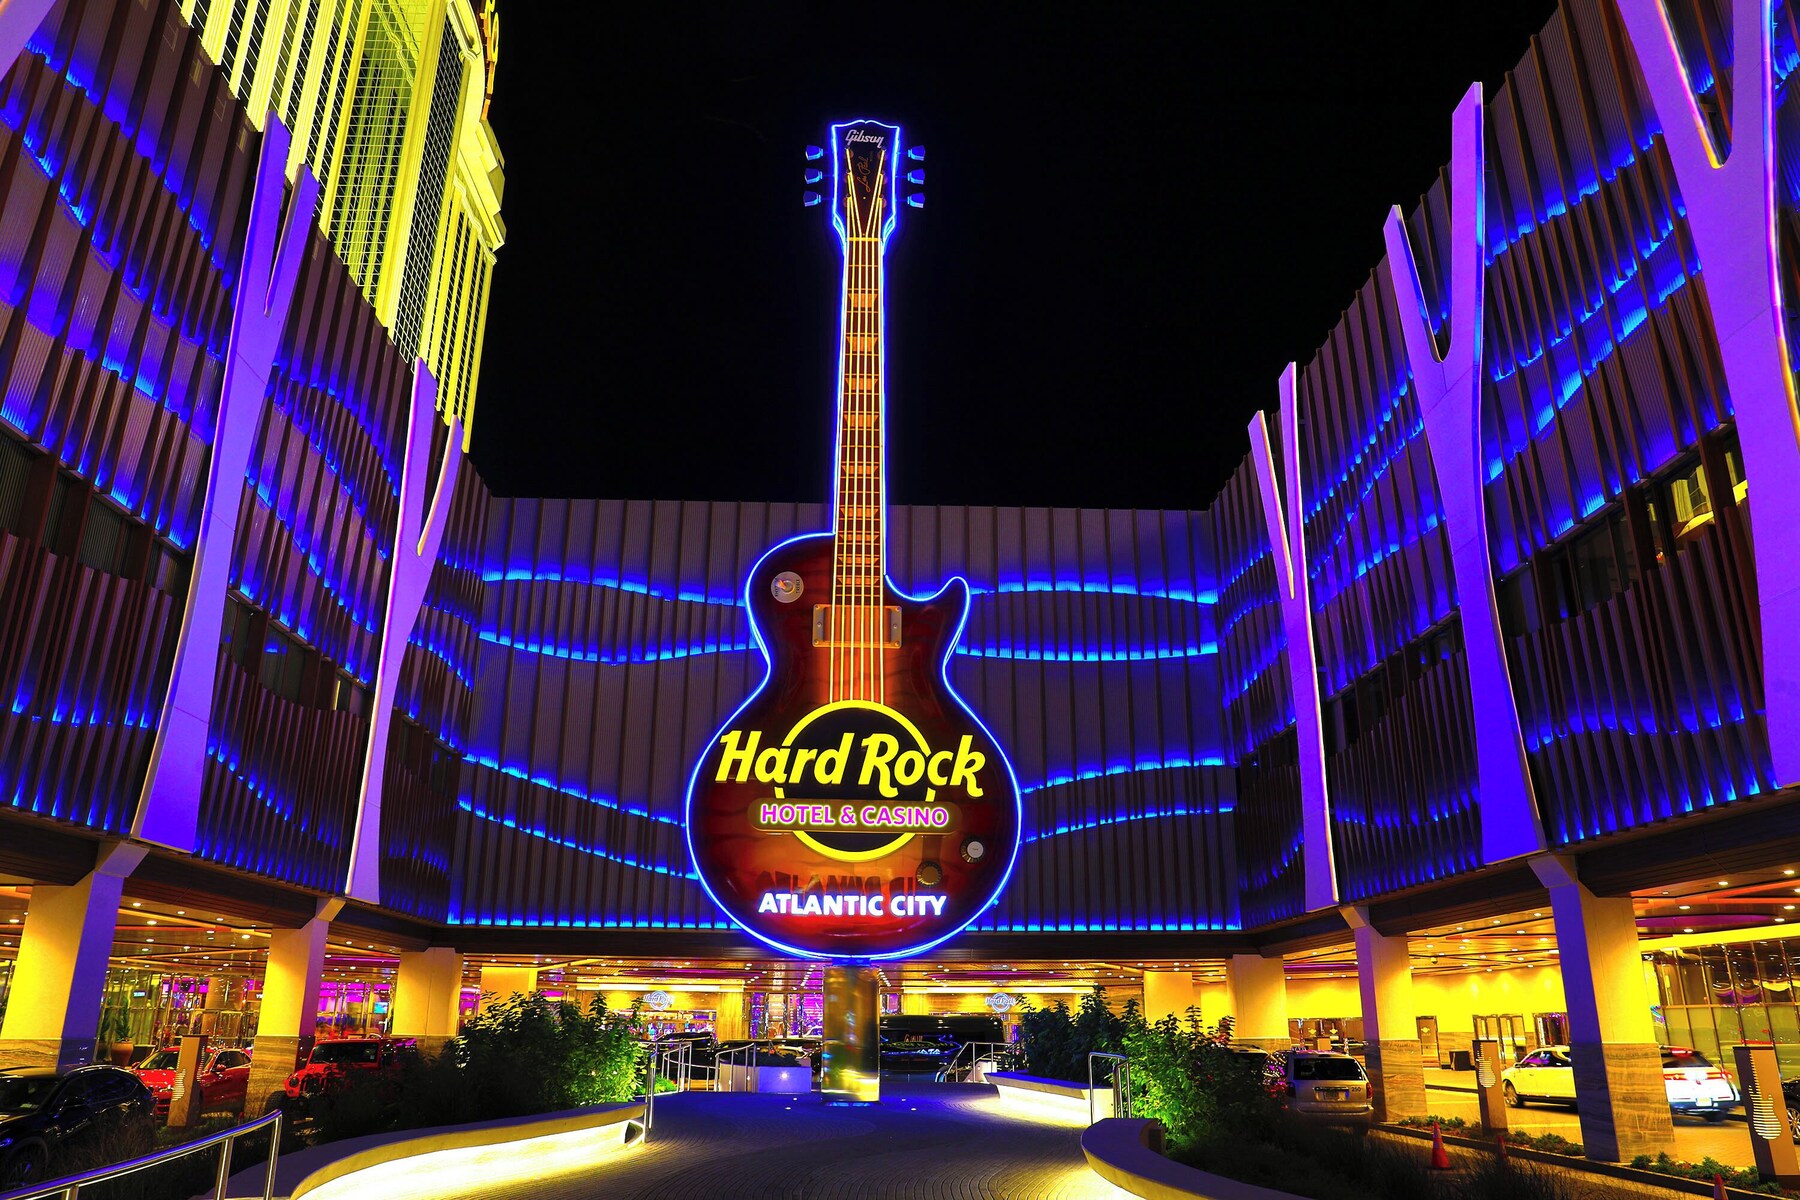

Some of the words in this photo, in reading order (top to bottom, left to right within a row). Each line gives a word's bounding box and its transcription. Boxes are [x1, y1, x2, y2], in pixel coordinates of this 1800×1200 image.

[845, 129, 885, 149] Gibson
[715, 730, 855, 784] Hard
[859, 733, 986, 798] Rock
[760, 804, 835, 825] HOTEL
[840, 805, 855, 825] &
[861, 806, 949, 827] CASINO
[758, 893, 884, 916] ATLANTIC
[890, 895, 947, 916] CITY
